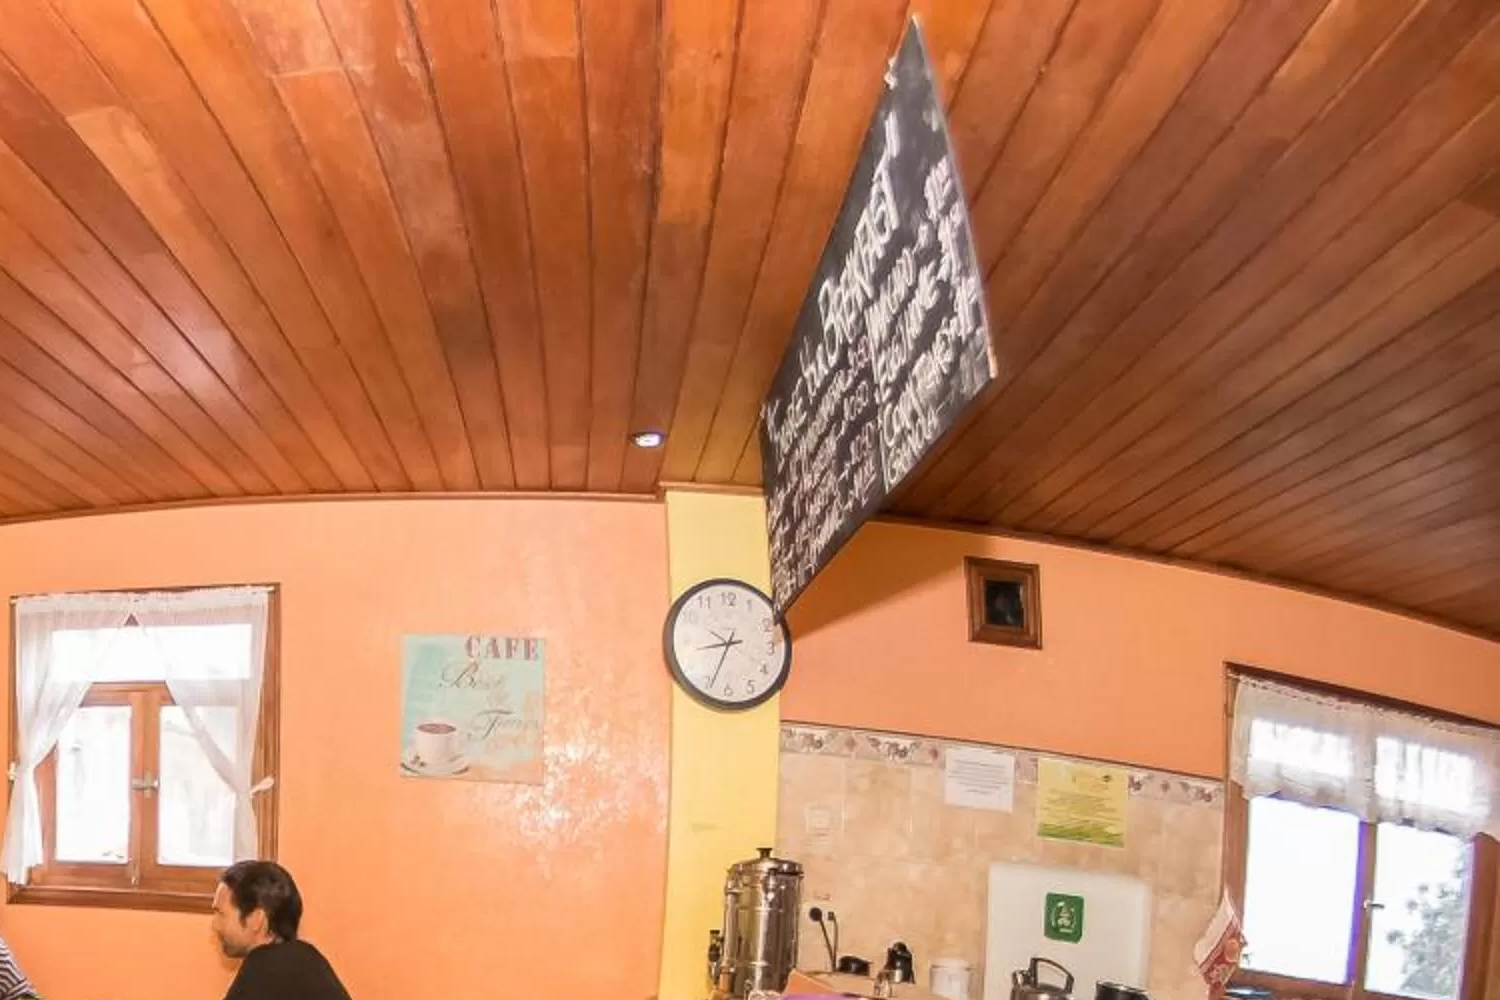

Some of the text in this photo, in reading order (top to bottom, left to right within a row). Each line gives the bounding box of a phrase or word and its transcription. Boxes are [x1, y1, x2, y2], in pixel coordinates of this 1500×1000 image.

[697, 595, 712, 610] 11
[720, 591, 737, 607] 12
[766, 641, 776, 657] 3
[759, 663, 769, 676] 4
[723, 682, 735, 697] 6
[745, 679, 756, 695] 5
